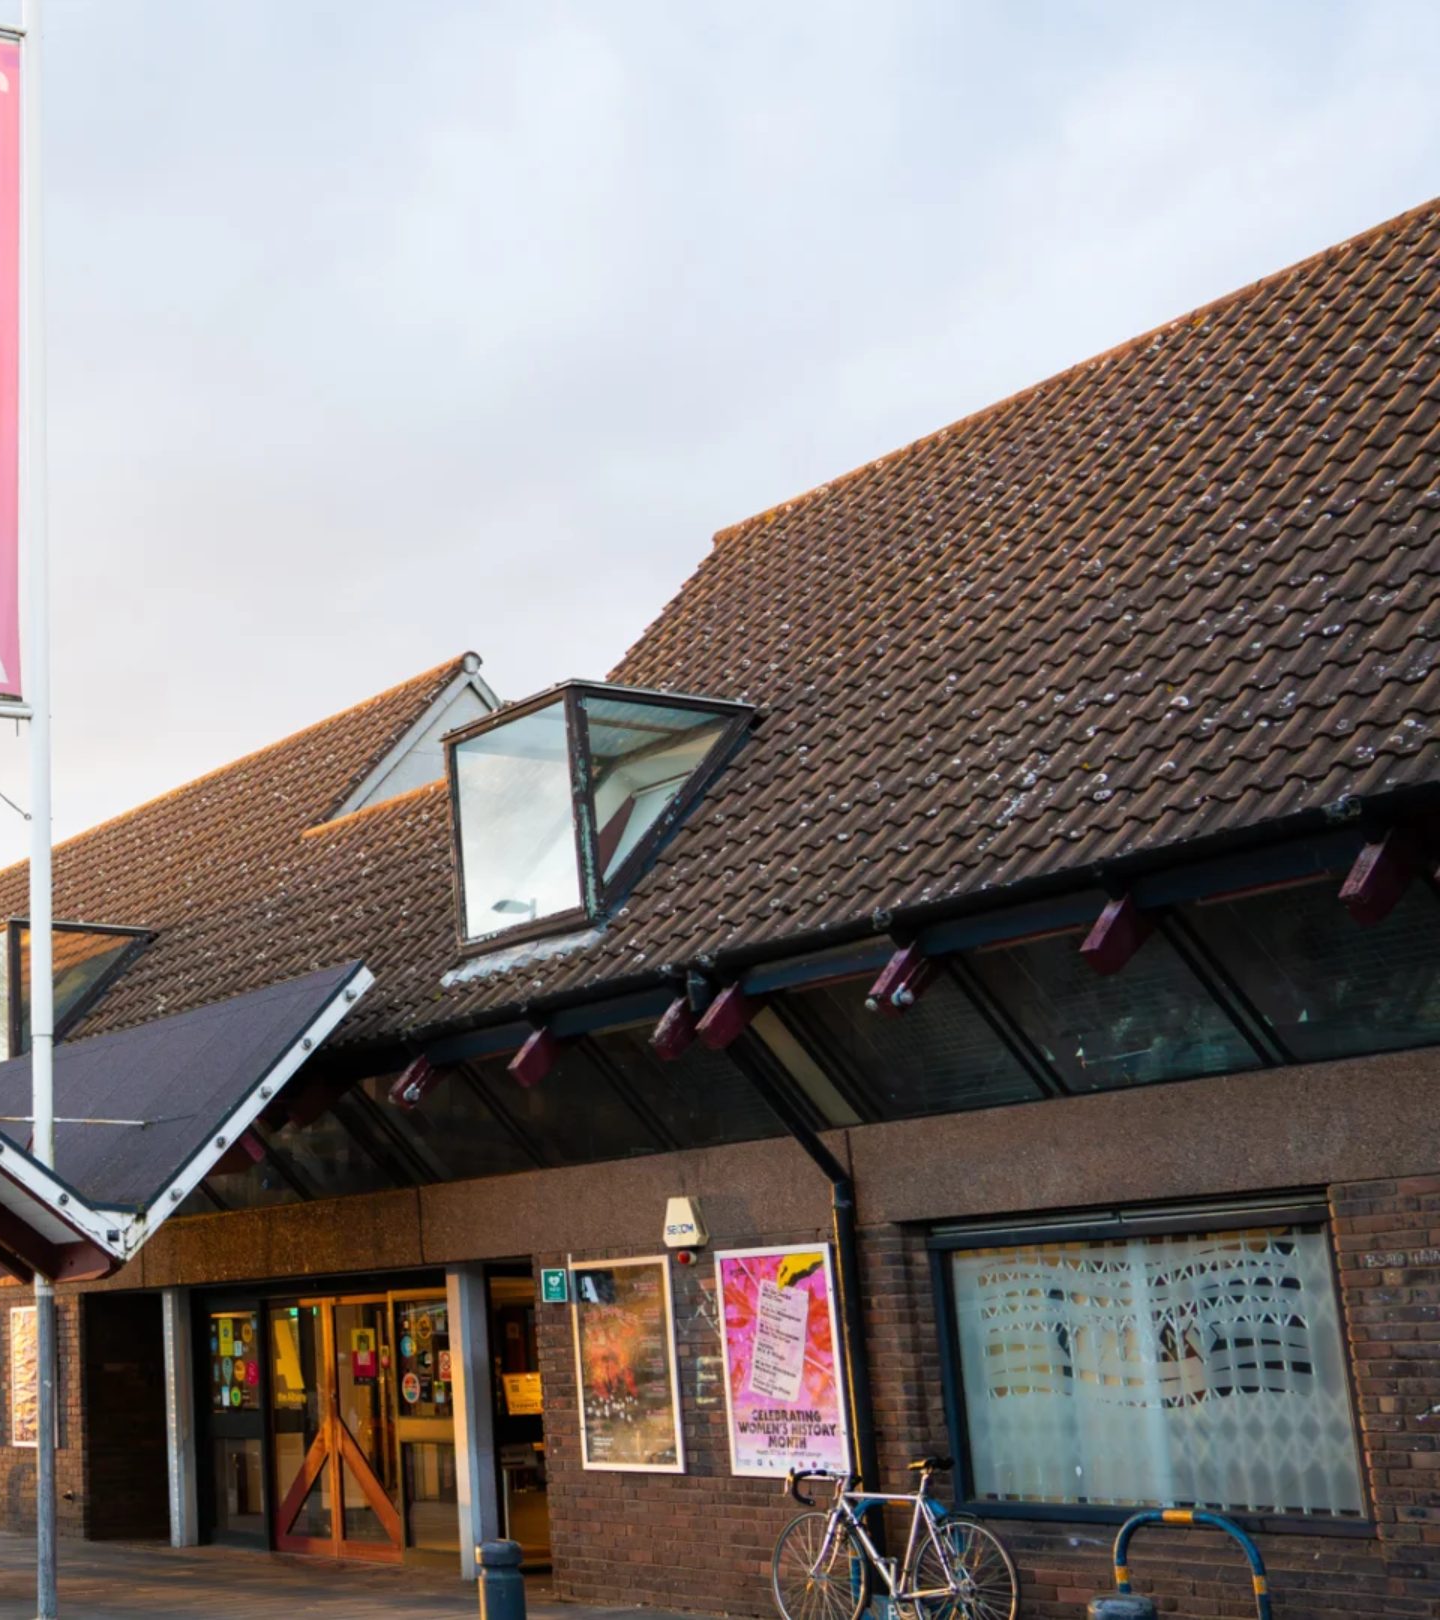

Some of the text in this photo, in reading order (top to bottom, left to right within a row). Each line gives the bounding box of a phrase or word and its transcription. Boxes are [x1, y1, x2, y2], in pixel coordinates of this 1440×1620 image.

[666, 1224, 694, 1235] SECOM
[752, 1409, 822, 1422] CELEBRATING
[738, 1422, 837, 1436] WOMEN'S HISTORY
[768, 1436, 807, 1449] MONTH
